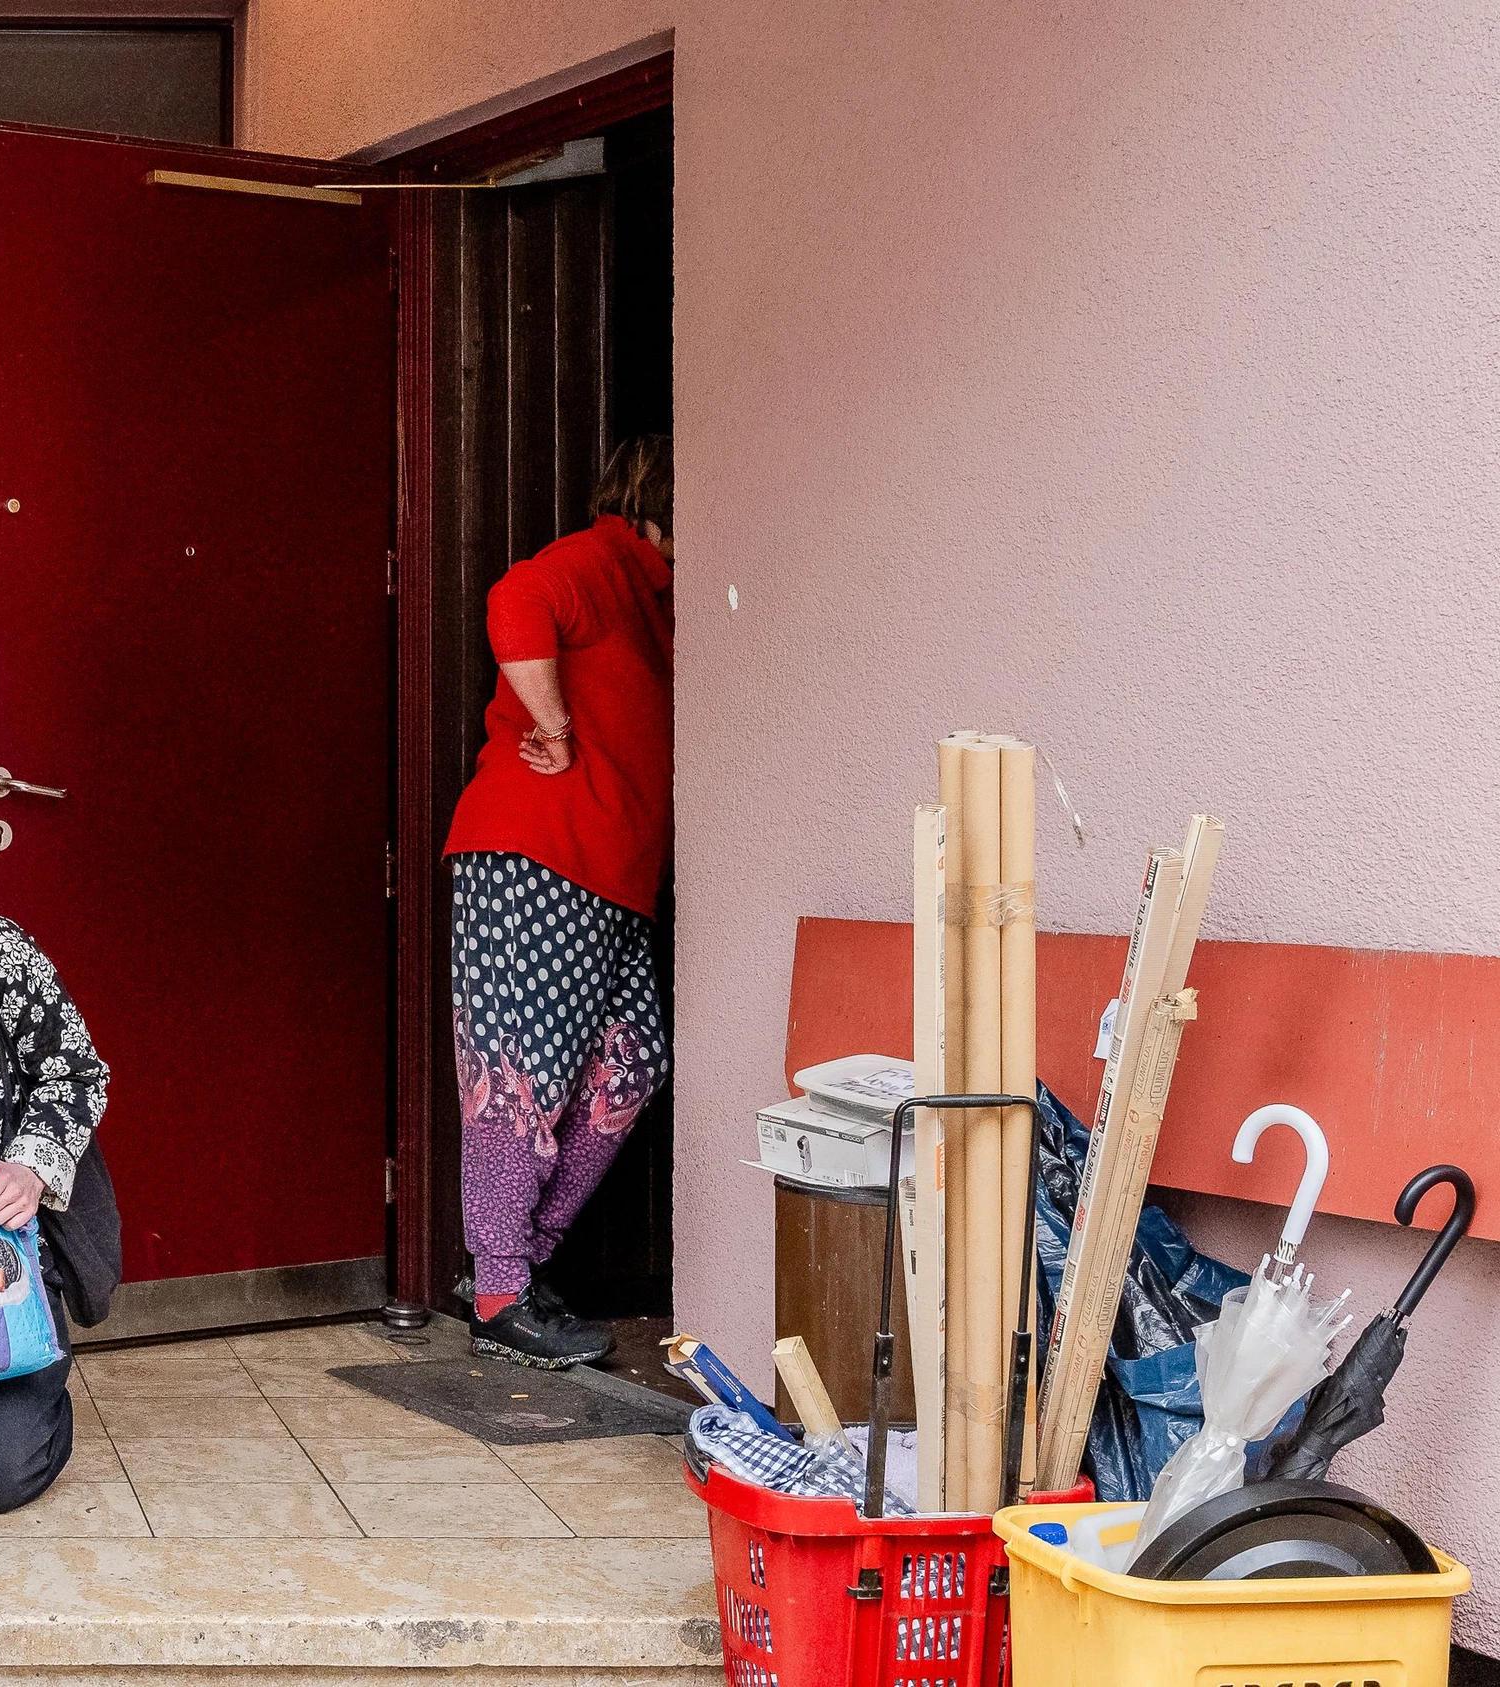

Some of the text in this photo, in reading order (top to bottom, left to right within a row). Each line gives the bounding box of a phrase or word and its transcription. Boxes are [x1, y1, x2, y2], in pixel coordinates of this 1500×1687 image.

[1121, 978, 1132, 1004] RED
[1153, 1050, 1171, 1096] LUMILUX
[1100, 1093, 1110, 1123] PHILIPS
[1138, 1134, 1153, 1171] OSRAM
[1075, 1205, 1086, 1232] RED
[1101, 1280, 1118, 1322] LUMILUX
[1055, 1314, 1065, 1342] PHILIPS
[1086, 1358, 1100, 1393] OSRAM
